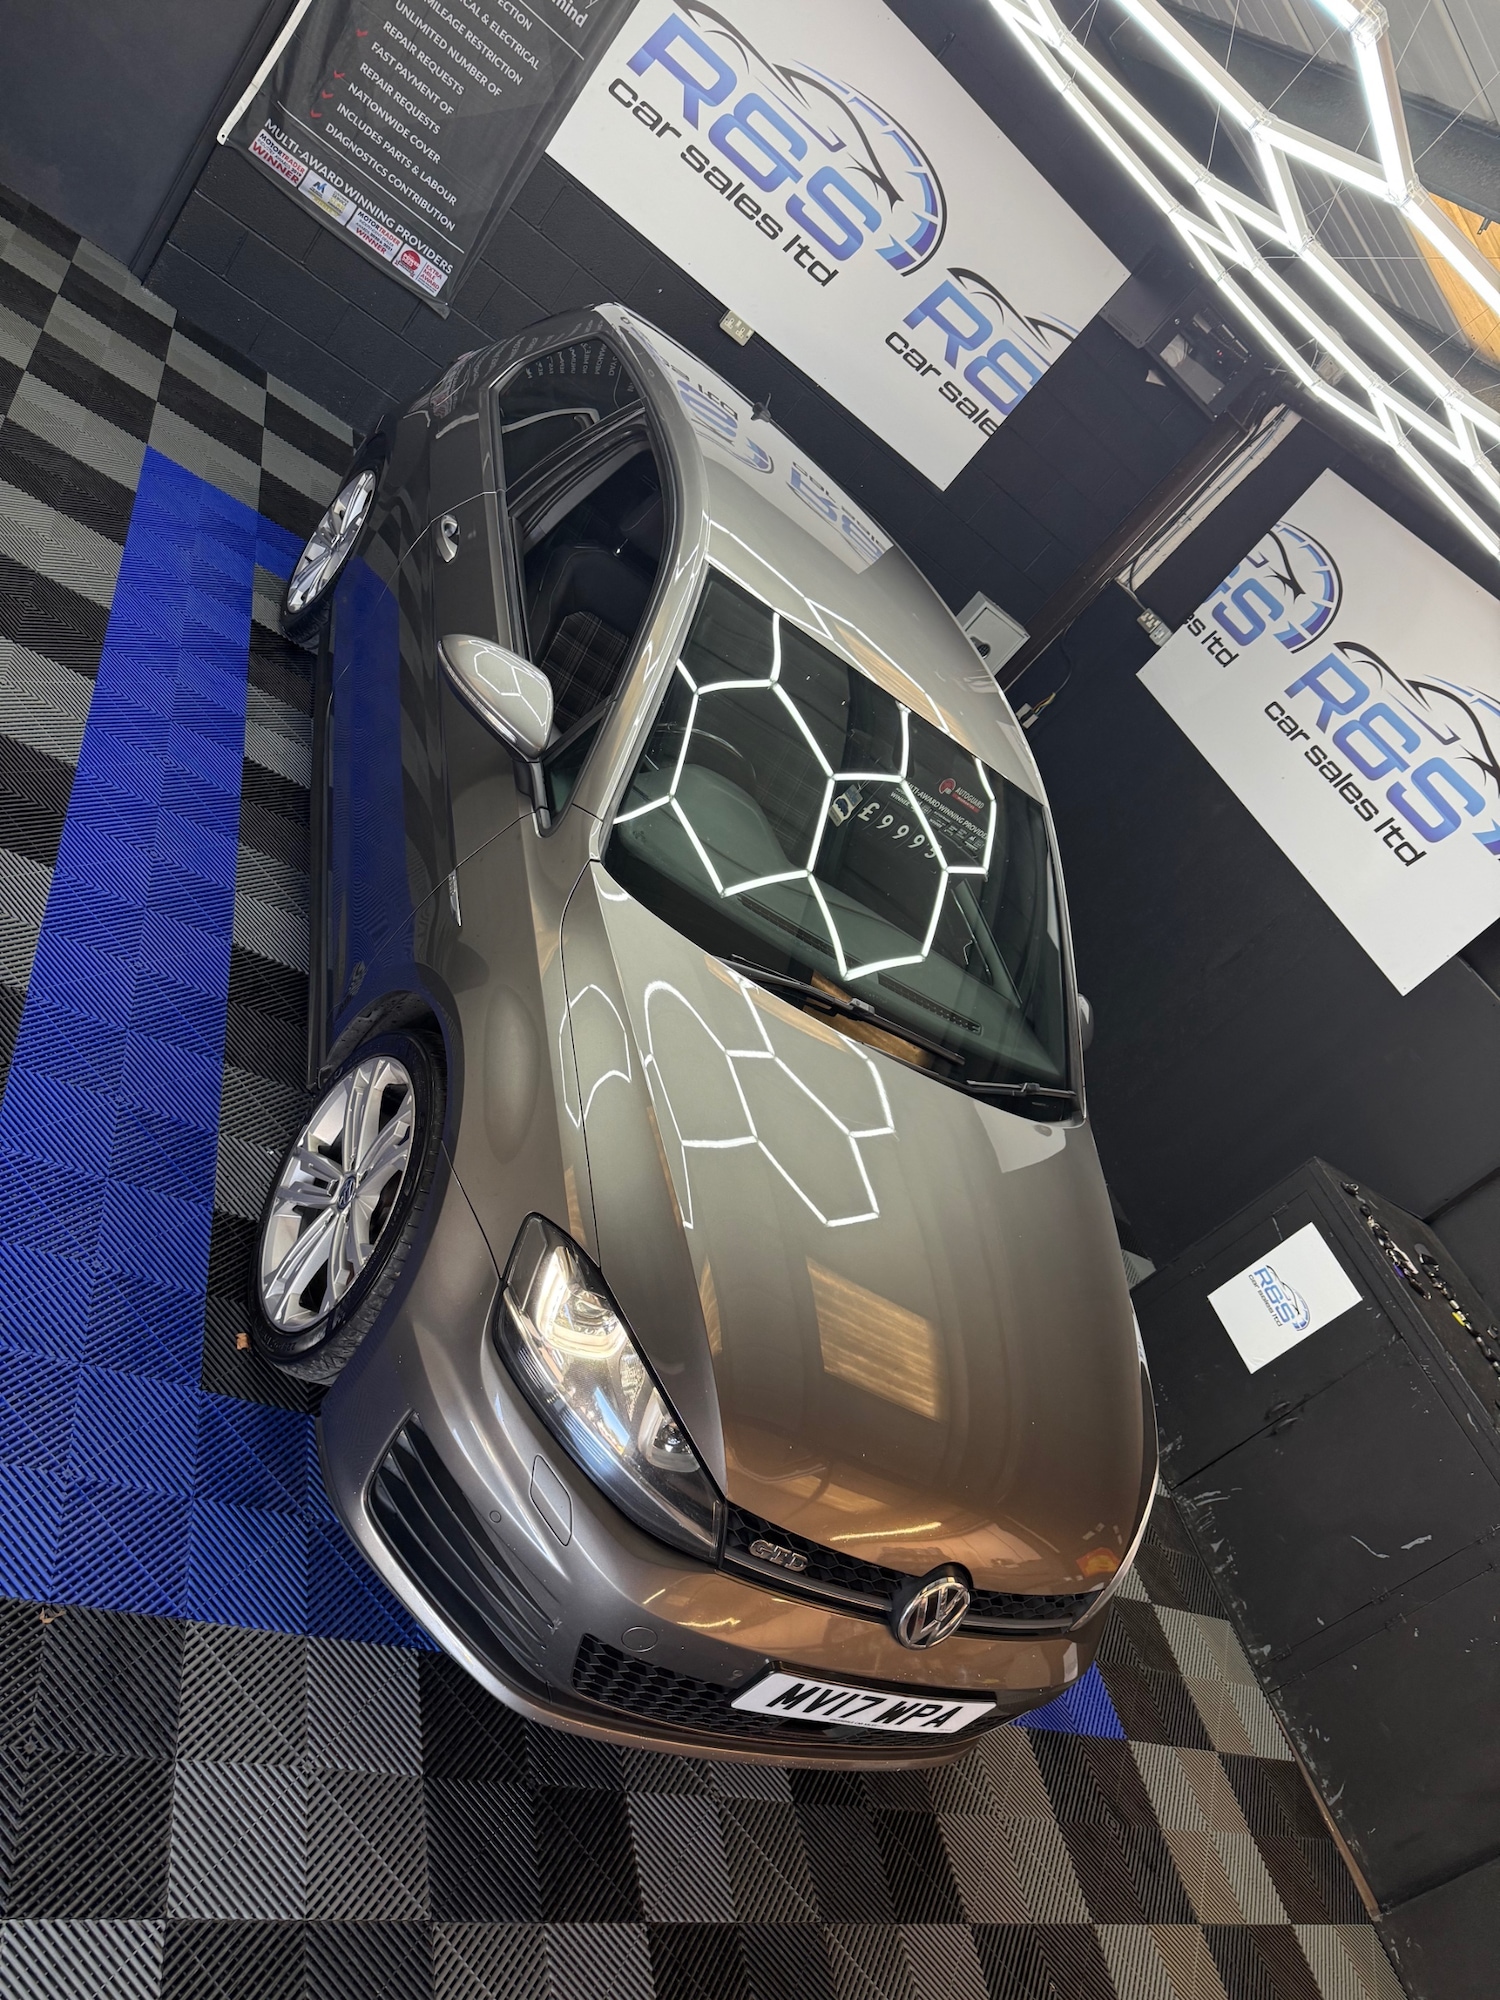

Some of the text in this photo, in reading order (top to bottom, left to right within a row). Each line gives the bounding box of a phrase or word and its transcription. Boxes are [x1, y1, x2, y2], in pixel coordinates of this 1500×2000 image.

[383, 20, 465, 96] REPAIR REQUESTS
[395, 0, 503, 97] UNLIMITED NUMBER OF
[424, 0, 523, 86] MILEAGE RESTRICTION
[460, 0, 540, 71] CAL & ELECTRICAL
[359, 62, 441, 135] REPAIR REQUESTS
[370, 41, 454, 115] FAST PAYMENT OF
[259, 133, 305, 175] MOTORTRADER
[336, 102, 457, 206] INCLUDES PARTS & LABOUR
[348, 82, 441, 164] NATIONWIDE COVER
[626, 13, 882, 262] R&S
[252, 141, 300, 184] WINNER
[325, 122, 456, 231] DIAGNOSTICS CONTRIBUTION
[608, 77, 839, 287] car sales ltd
[264, 118, 344, 188] MULTI-AWARD
[344, 183, 396, 229] WINNING
[394, 224, 453, 274] PROVIDERS
[355, 227, 387, 255] WINNER
[358, 211, 400, 246] MOTORTRADER
[420, 273, 440, 290] AWARD
[426, 264, 442, 280] EXTRA
[885, 331, 942, 377] car
[1201, 630, 1240, 668] ltd
[1283, 653, 1486, 843] R&S
[908, 782, 941, 808] ULTI-AWARD
[938, 804, 964, 823] WINNING
[961, 819, 988, 840] PROVIDE
[954, 787, 985, 809] AUTOGUARD
[1264, 700, 1427, 868] car sales ltd
[1248, 1274, 1283, 1327] car sales ltd
[1254, 1267, 1295, 1323] R&S
[749, 1539, 809, 1572] GTD
[766, 1683, 964, 1728] MV17 WPA
